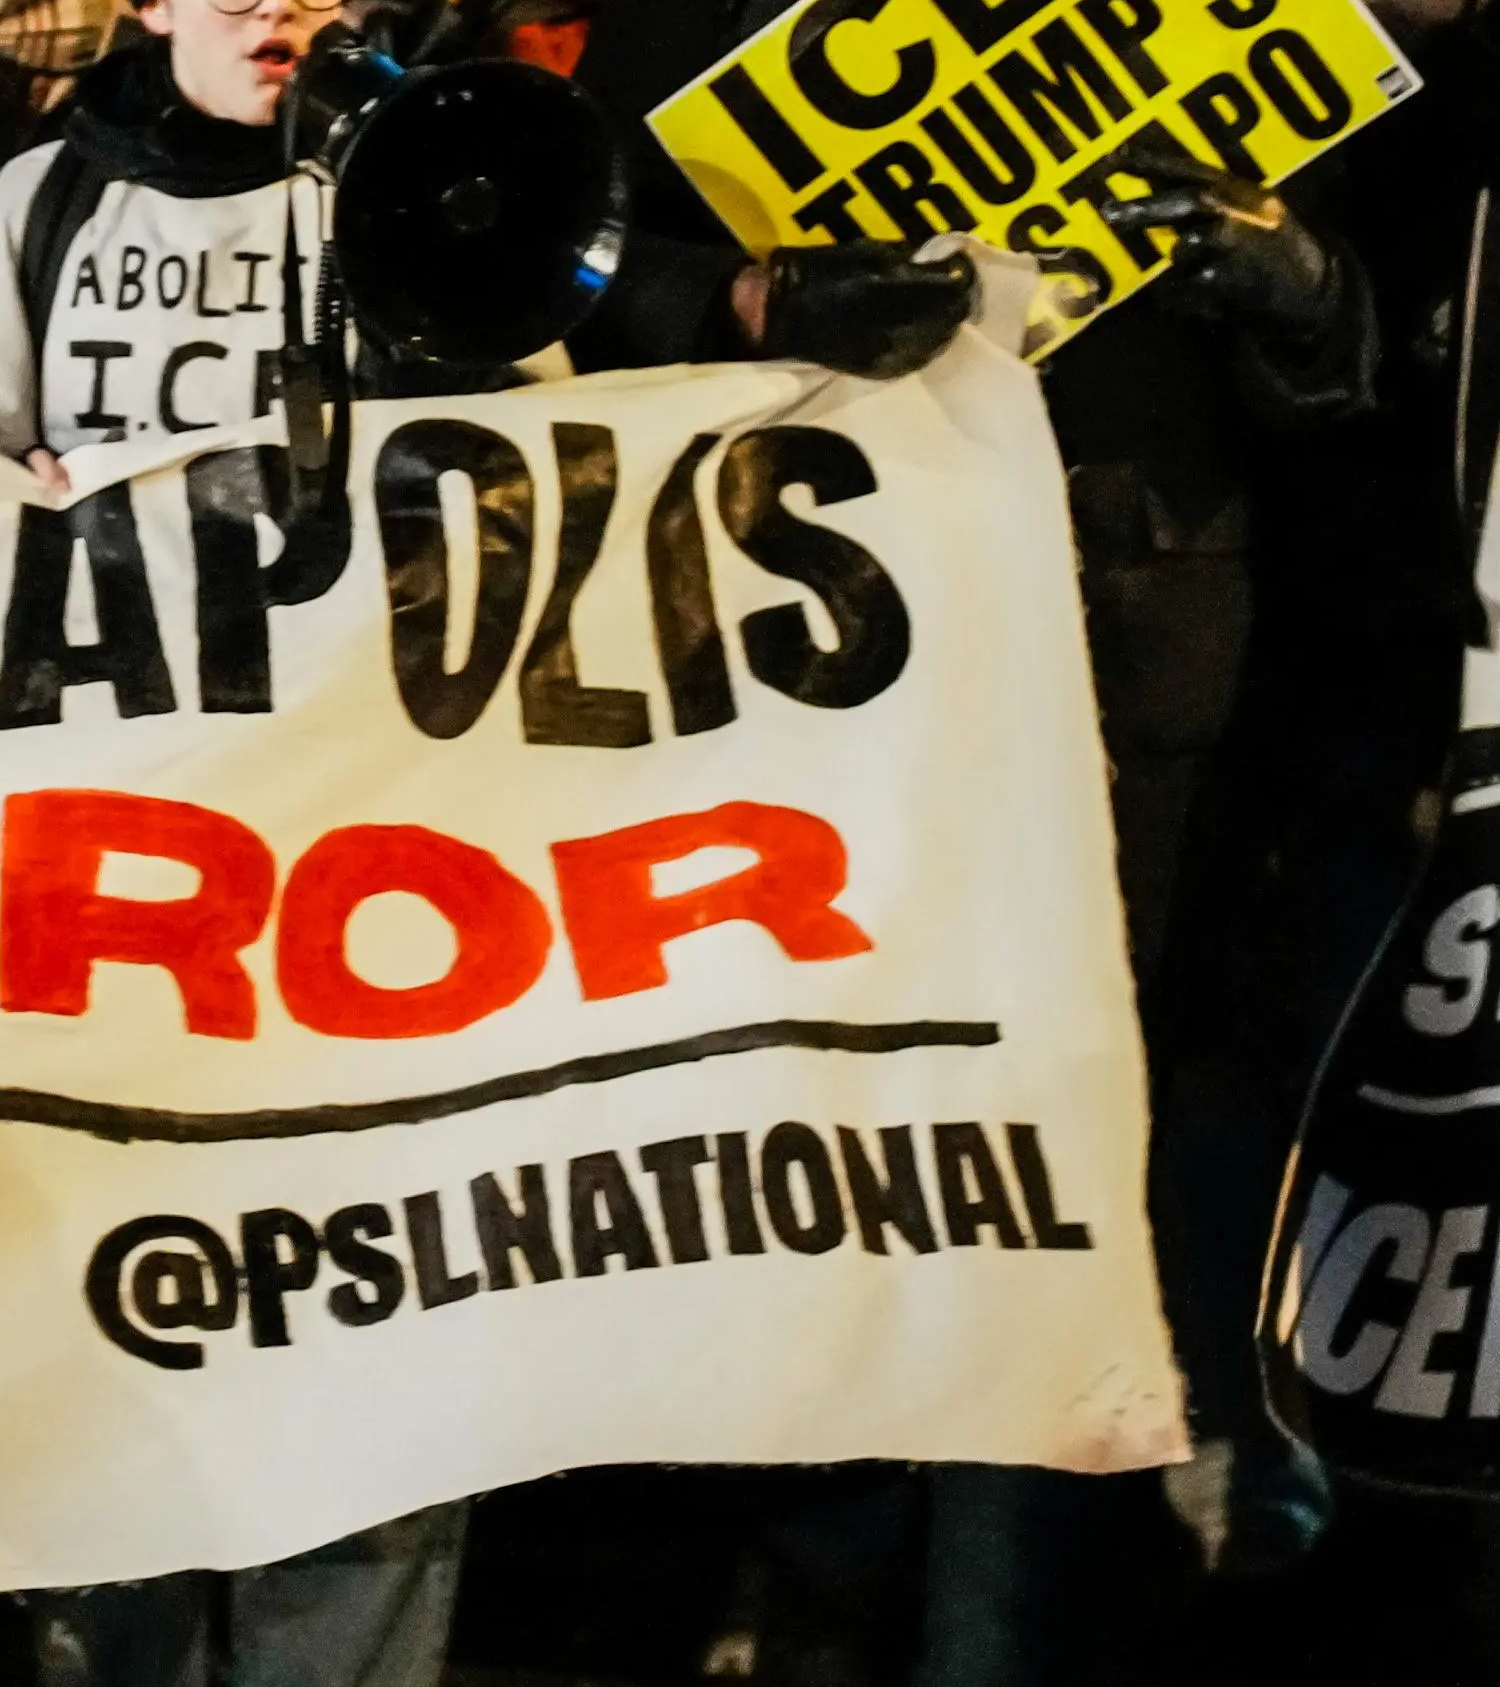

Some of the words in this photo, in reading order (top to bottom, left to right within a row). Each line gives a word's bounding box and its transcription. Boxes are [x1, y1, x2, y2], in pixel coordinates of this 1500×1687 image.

[71, 244, 309, 317] ABOLI
[986, 28, 1352, 355] STAPO
[83, 1121, 1094, 1371] @PSLNATIONAL
